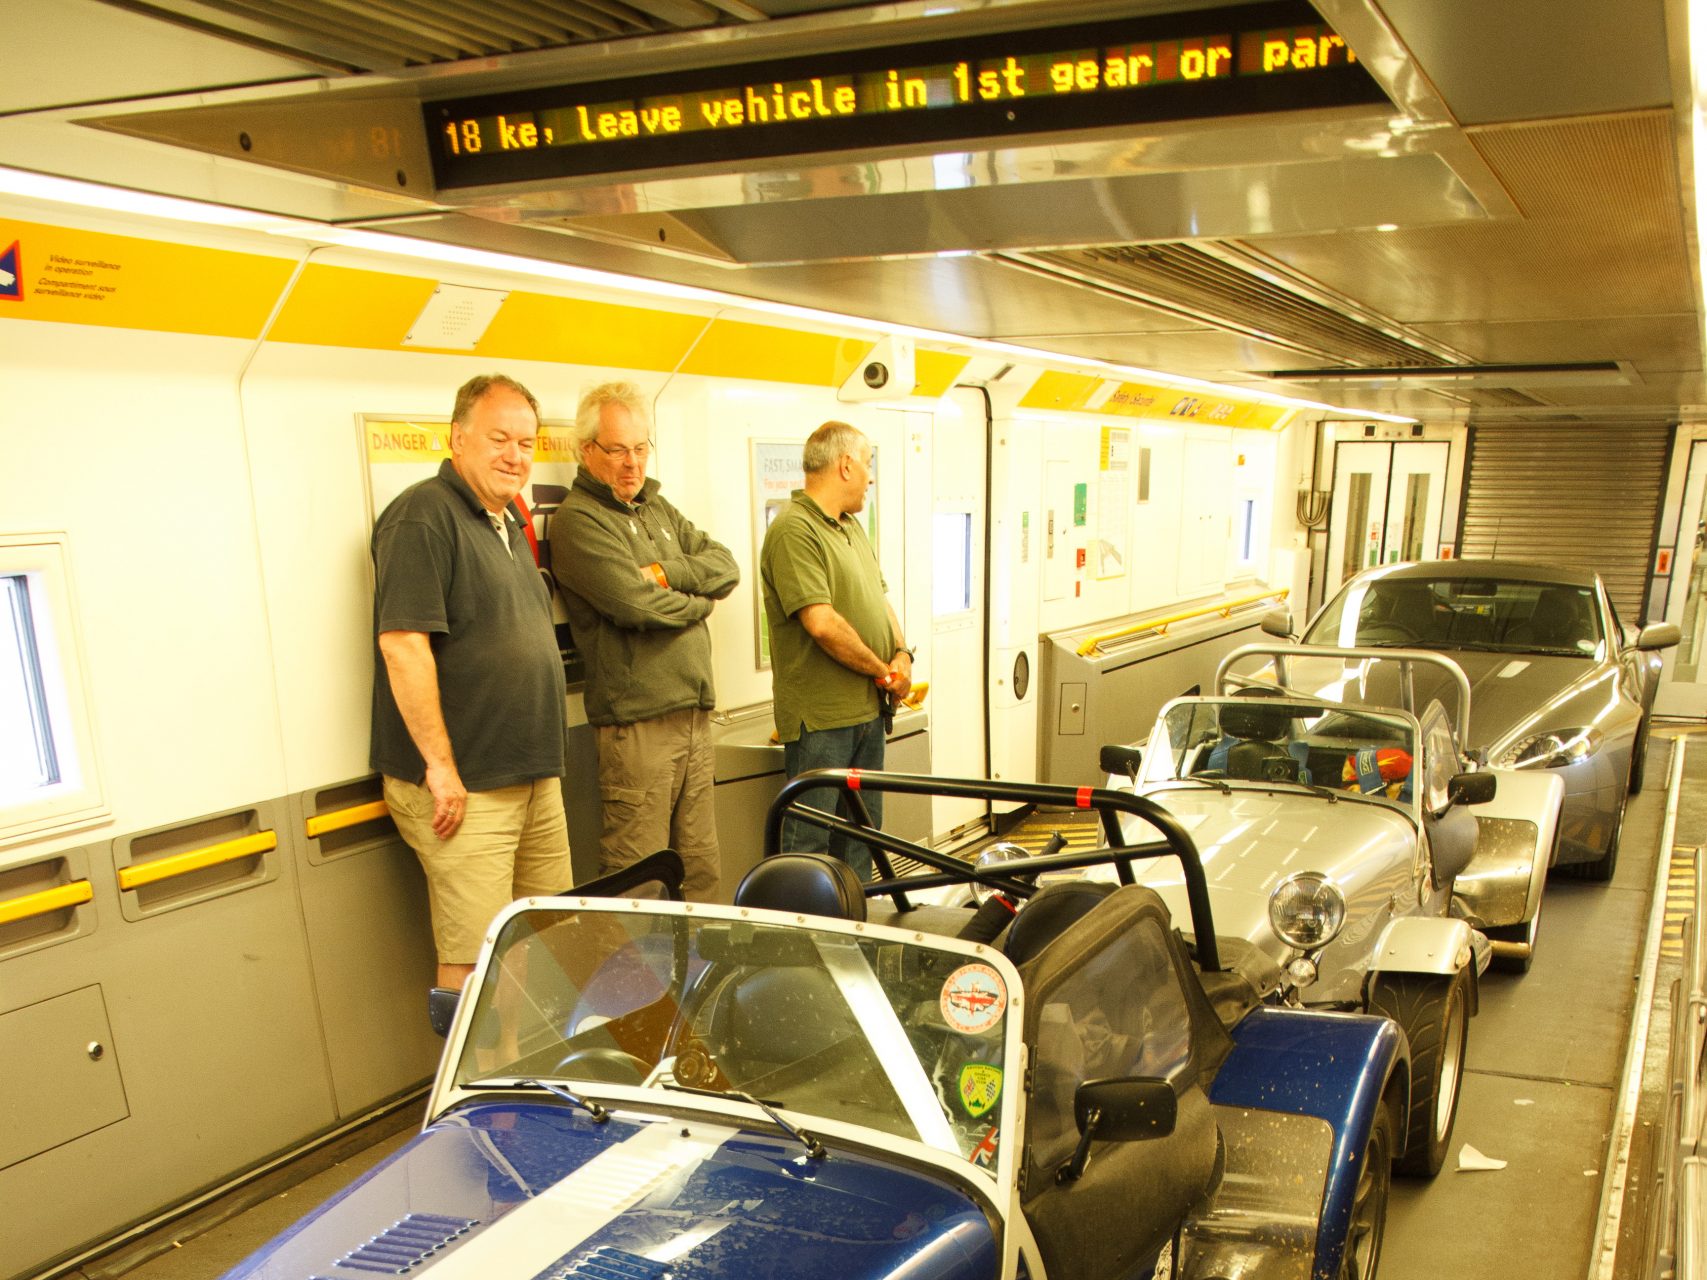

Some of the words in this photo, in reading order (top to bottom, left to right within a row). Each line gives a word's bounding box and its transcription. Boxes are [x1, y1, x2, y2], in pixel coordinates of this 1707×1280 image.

[446, 119, 482, 155] 18
[577, 105, 682, 141] leave
[701, 78, 856, 127] vehicle
[886, 69, 928, 109] in
[953, 57, 1025, 101] 1st
[1050, 55, 1153, 92] gear
[1180, 46, 1232, 80] or
[50, 254, 74, 265] Video
[75, 260, 121, 271] surveillance
[54, 266, 94, 276] operation
[33, 288, 82, 299] surveillance
[373, 433, 427, 450] DANGER
